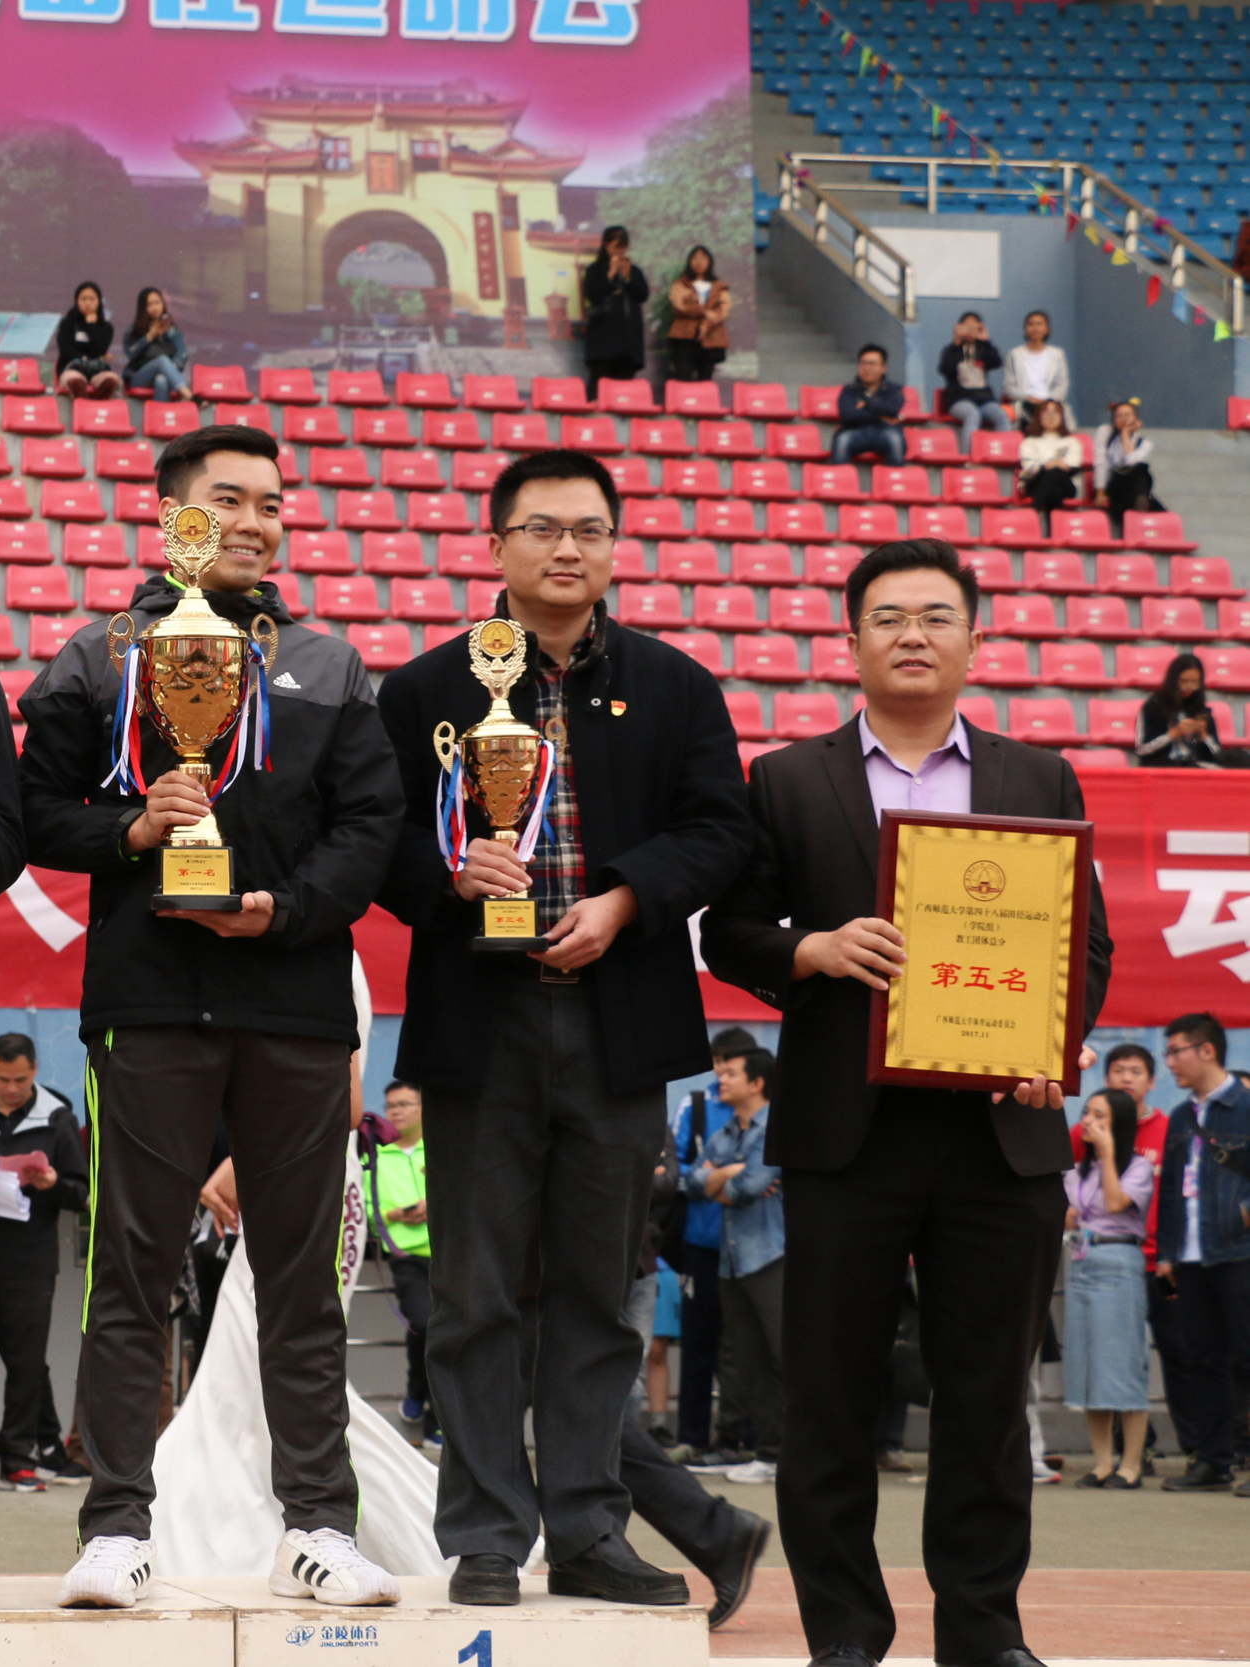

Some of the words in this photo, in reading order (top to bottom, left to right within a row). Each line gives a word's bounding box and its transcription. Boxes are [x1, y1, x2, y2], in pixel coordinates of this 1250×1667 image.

[177, 868, 215, 877] 第一名
[930, 961, 1028, 993] 第五名
[961, 1030, 989, 1038] 2017.11
[320, 1625, 378, 1641] 金陵体育
[458, 1629, 492, 1667] 1
